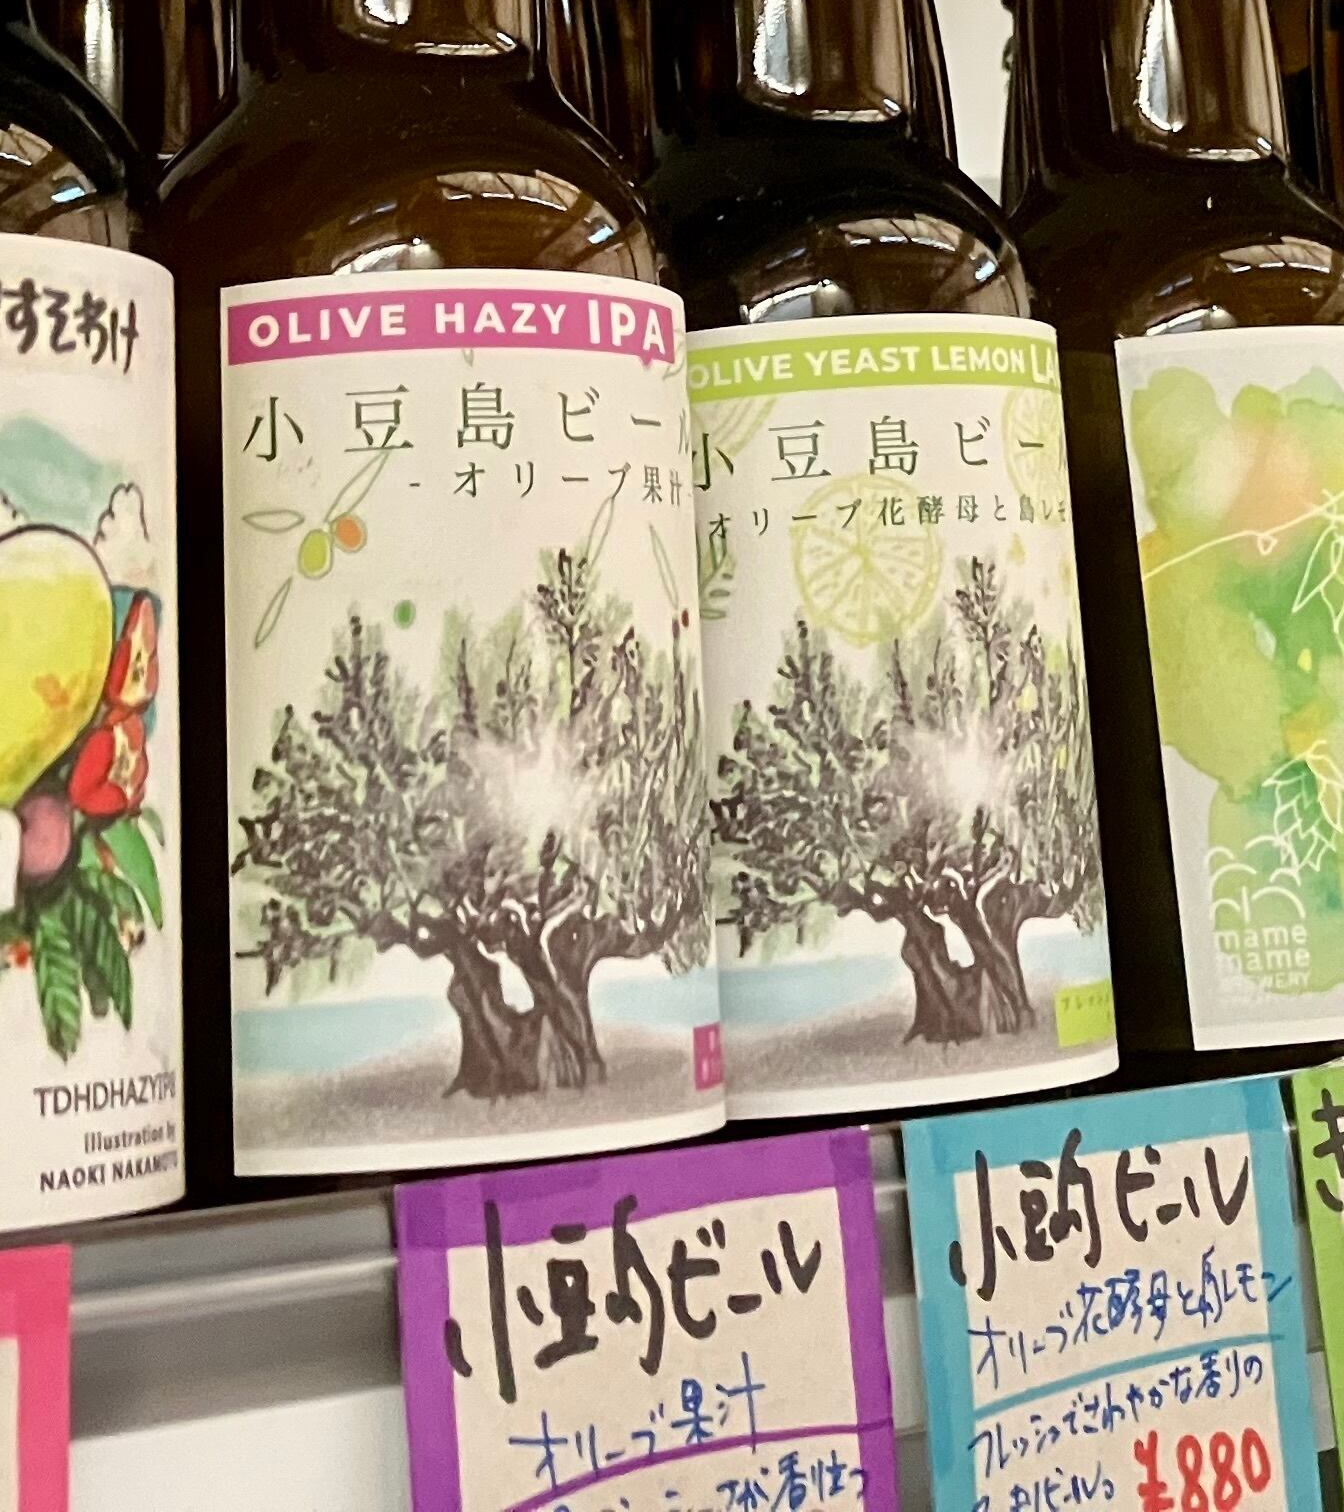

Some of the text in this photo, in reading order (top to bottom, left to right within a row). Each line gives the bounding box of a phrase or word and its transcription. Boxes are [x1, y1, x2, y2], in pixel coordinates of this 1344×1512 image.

[247, 299, 667, 355] OLIVE HAZY IPA
[687, 352, 793, 388] OLIVE
[804, 345, 921, 378] YEAST
[931, 345, 1026, 373] LEMON
[1214, 924, 1308, 951] mame
[39, 1163, 106, 1192] NAOKI
